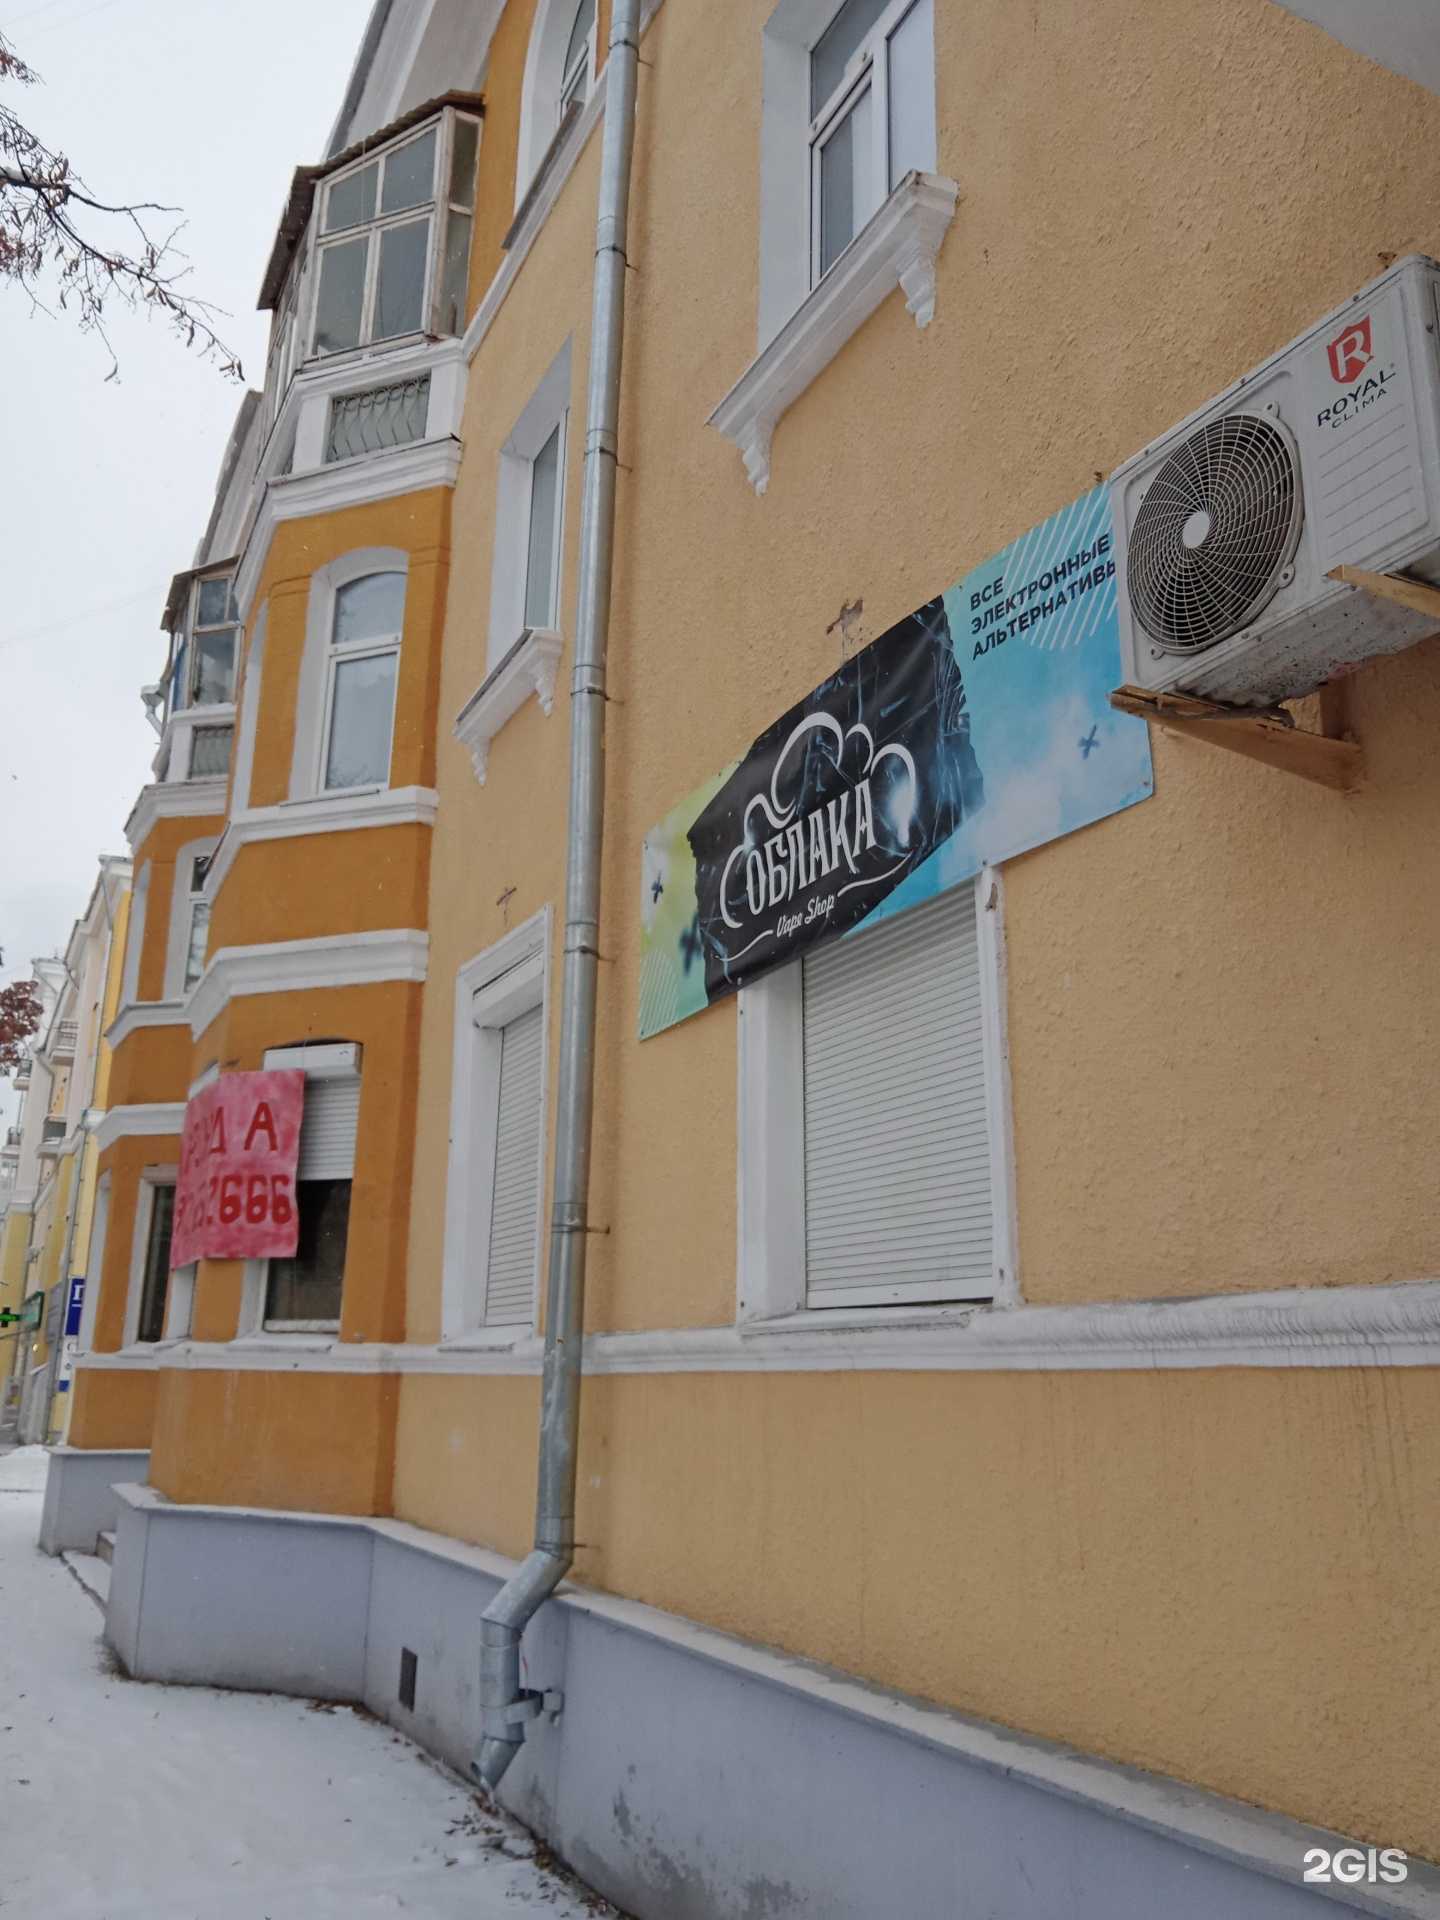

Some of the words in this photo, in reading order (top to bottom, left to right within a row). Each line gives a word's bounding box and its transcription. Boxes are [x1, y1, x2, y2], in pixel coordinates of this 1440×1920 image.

[1316, 369, 1397, 427] ROYAL
[1331, 387, 1388, 429] CLIMA
[969, 576, 1005, 612] ВСЕ
[970, 532, 1111, 636] ЭЛЕКТРОННЫЕ
[745, 778, 877, 916] ОБЛАКА
[776, 911, 803, 939] Vape
[803, 893, 835, 925] Shop
